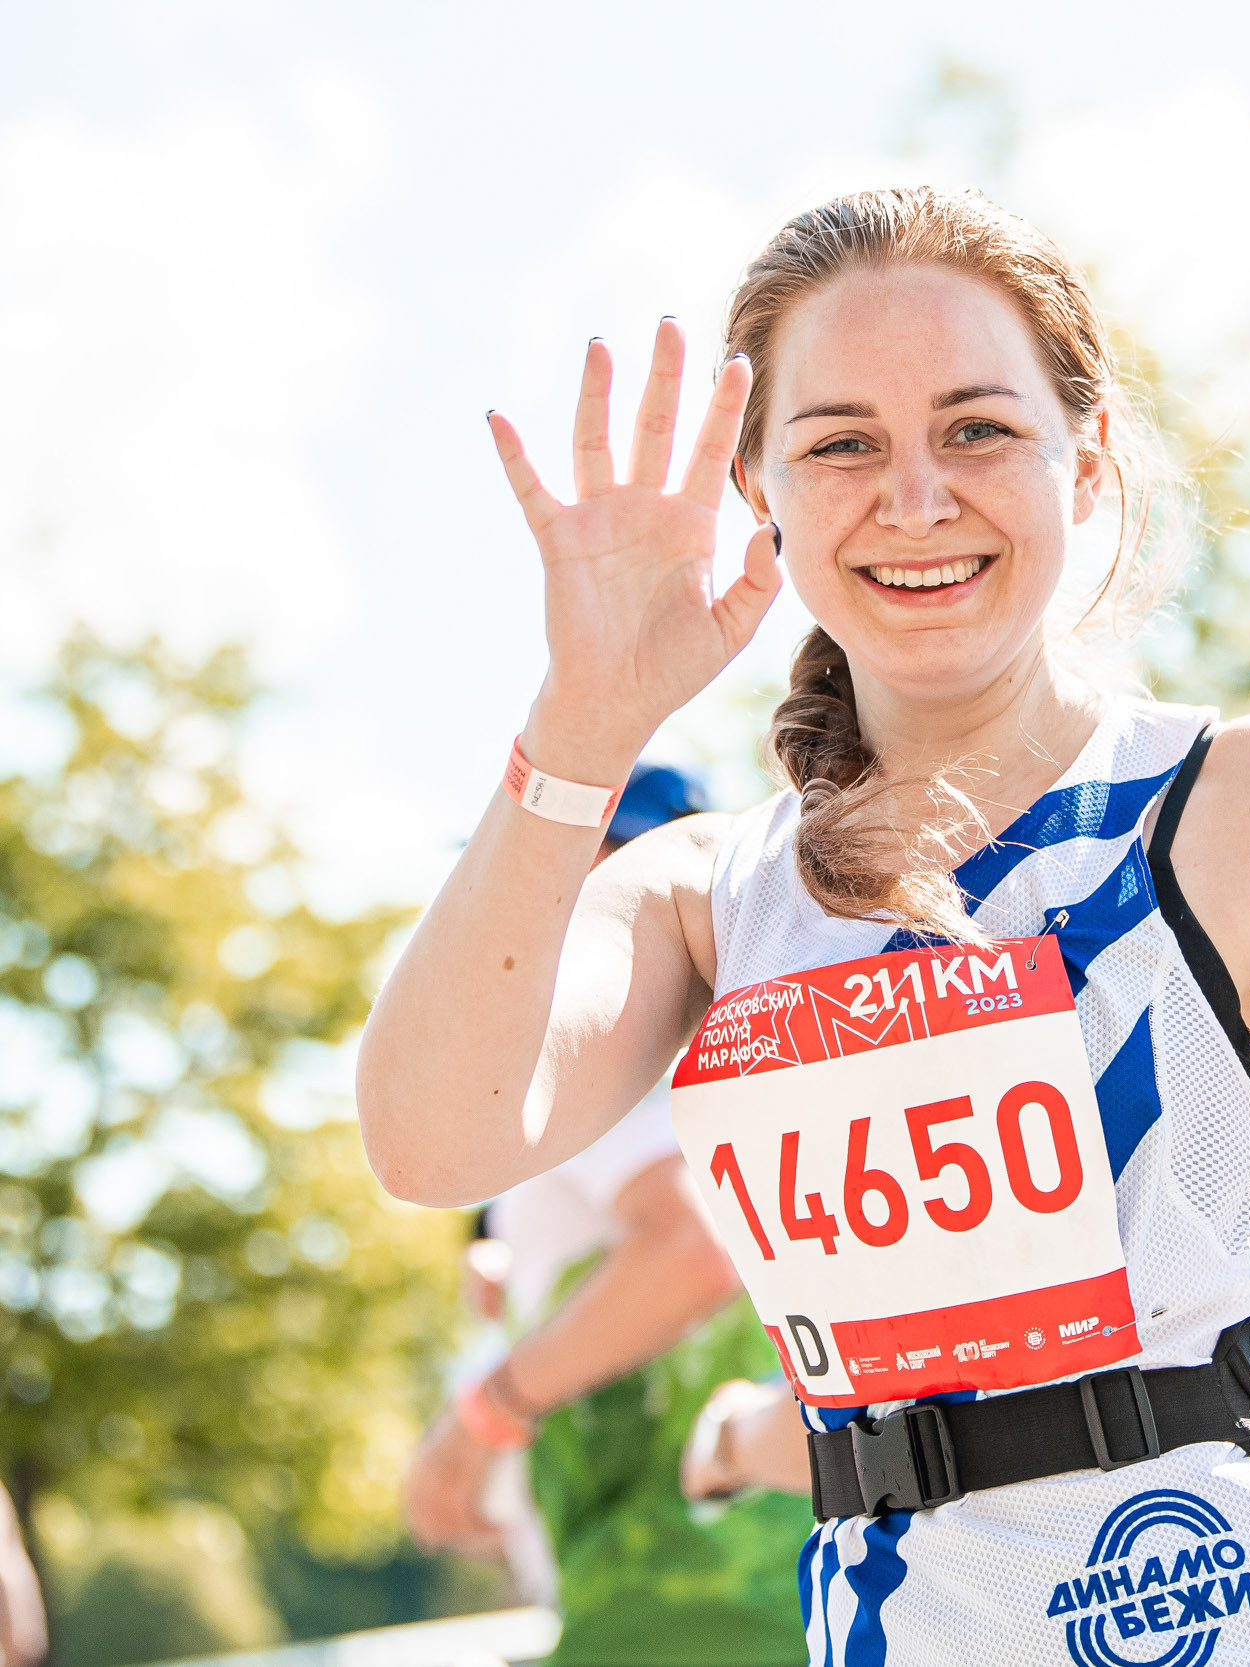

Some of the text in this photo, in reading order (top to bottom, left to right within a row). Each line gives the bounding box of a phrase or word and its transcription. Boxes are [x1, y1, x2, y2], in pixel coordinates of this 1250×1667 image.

[706, 982, 804, 1027] МОСКОВСКИЙ
[965, 992, 1023, 1016] 2023
[700, 1023, 739, 1049] ПОЛУ
[697, 1040, 779, 1071] МАРАФОН
[709, 1080, 1084, 1261] 14650
[1058, 1316, 1100, 1338] МИР
[785, 1314, 829, 1376] D
[952, 1341, 980, 1363] 100
[1046, 1539, 1246, 1618] ДИНАМО
